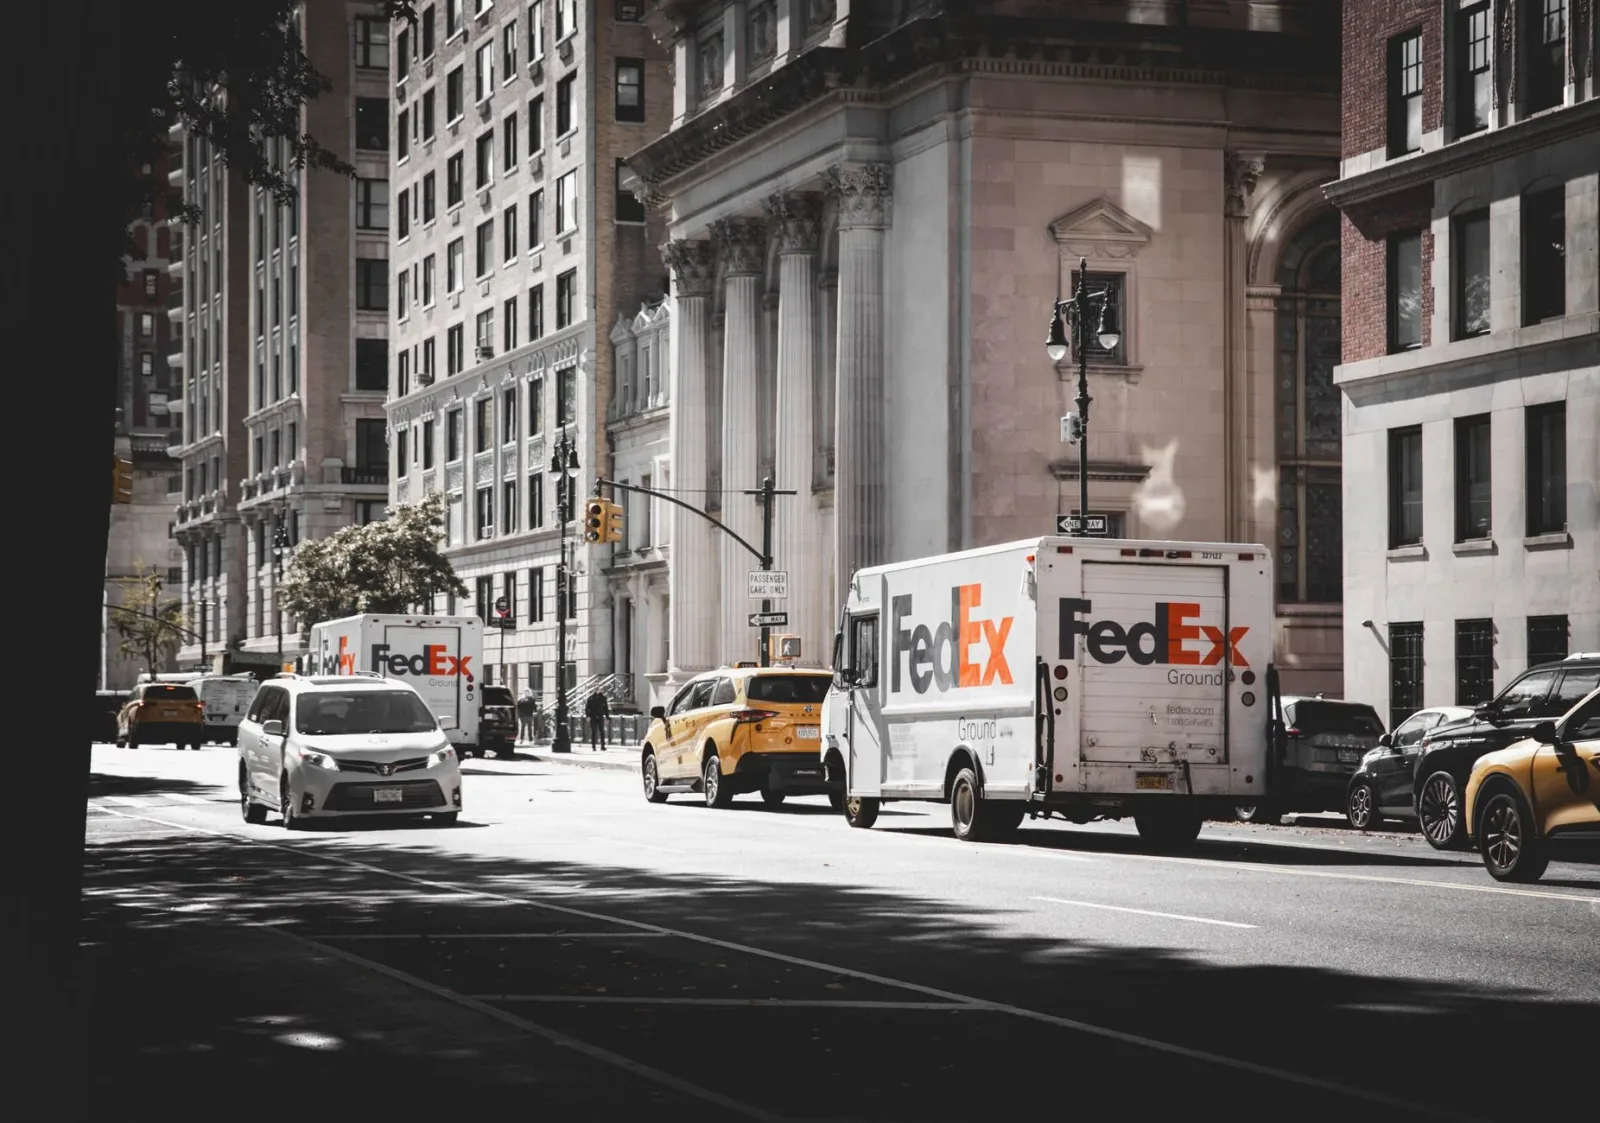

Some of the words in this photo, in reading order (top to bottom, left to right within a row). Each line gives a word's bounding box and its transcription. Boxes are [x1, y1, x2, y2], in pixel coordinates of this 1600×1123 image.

[1064, 520, 1079, 528] ONE
[1201, 552, 1222, 560] 327122
[750, 574, 785, 583] PASSENGER
[750, 585, 767, 594] CARS
[770, 585, 785, 594] ONLY
[1058, 597, 1250, 666] FedEx
[892, 583, 1014, 695] FedEx
[372, 644, 472, 676] FedEx
[1167, 669, 1224, 686] Ground
[429, 679, 458, 688] Ground
[1166, 704, 1214, 715] fedex.com
[958, 715, 996, 740] Ground
